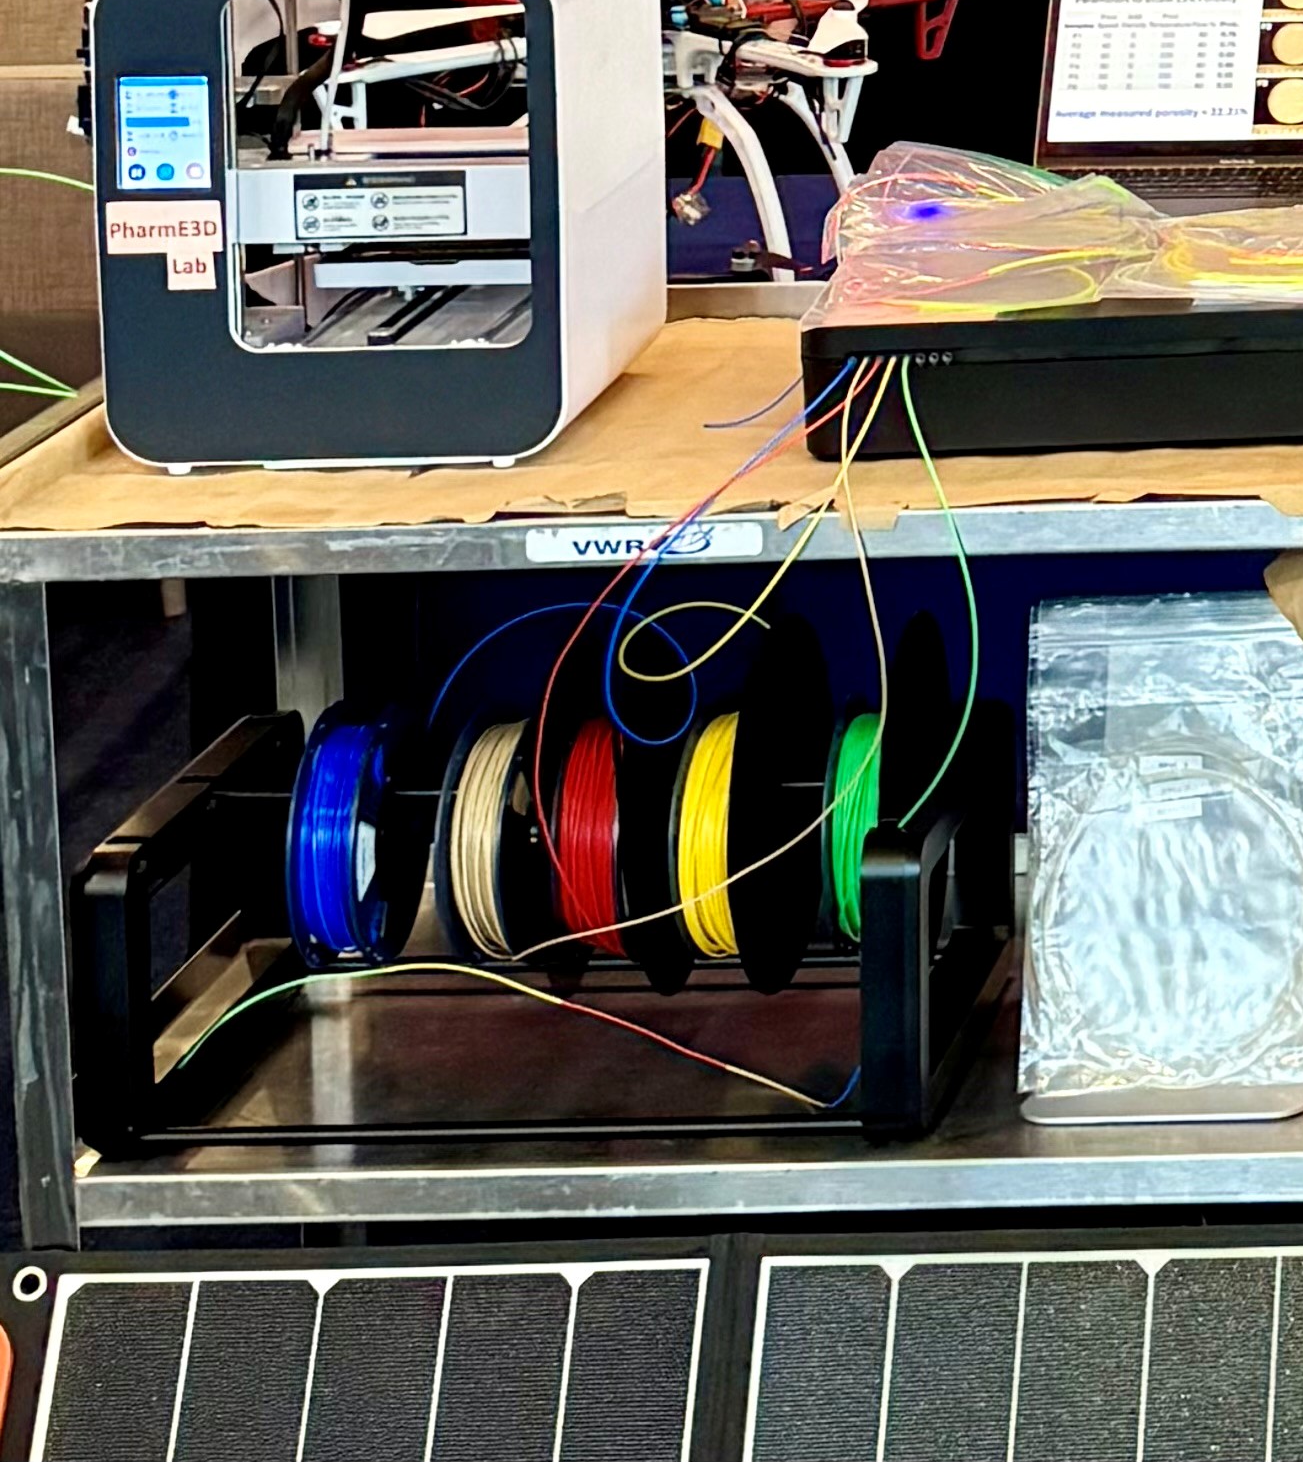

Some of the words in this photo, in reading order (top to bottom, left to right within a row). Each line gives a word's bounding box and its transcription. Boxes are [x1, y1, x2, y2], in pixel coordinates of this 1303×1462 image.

[109, 220, 218, 239] PharmE3D
[172, 257, 208, 275] Lab
[572, 539, 645, 556] VWR
